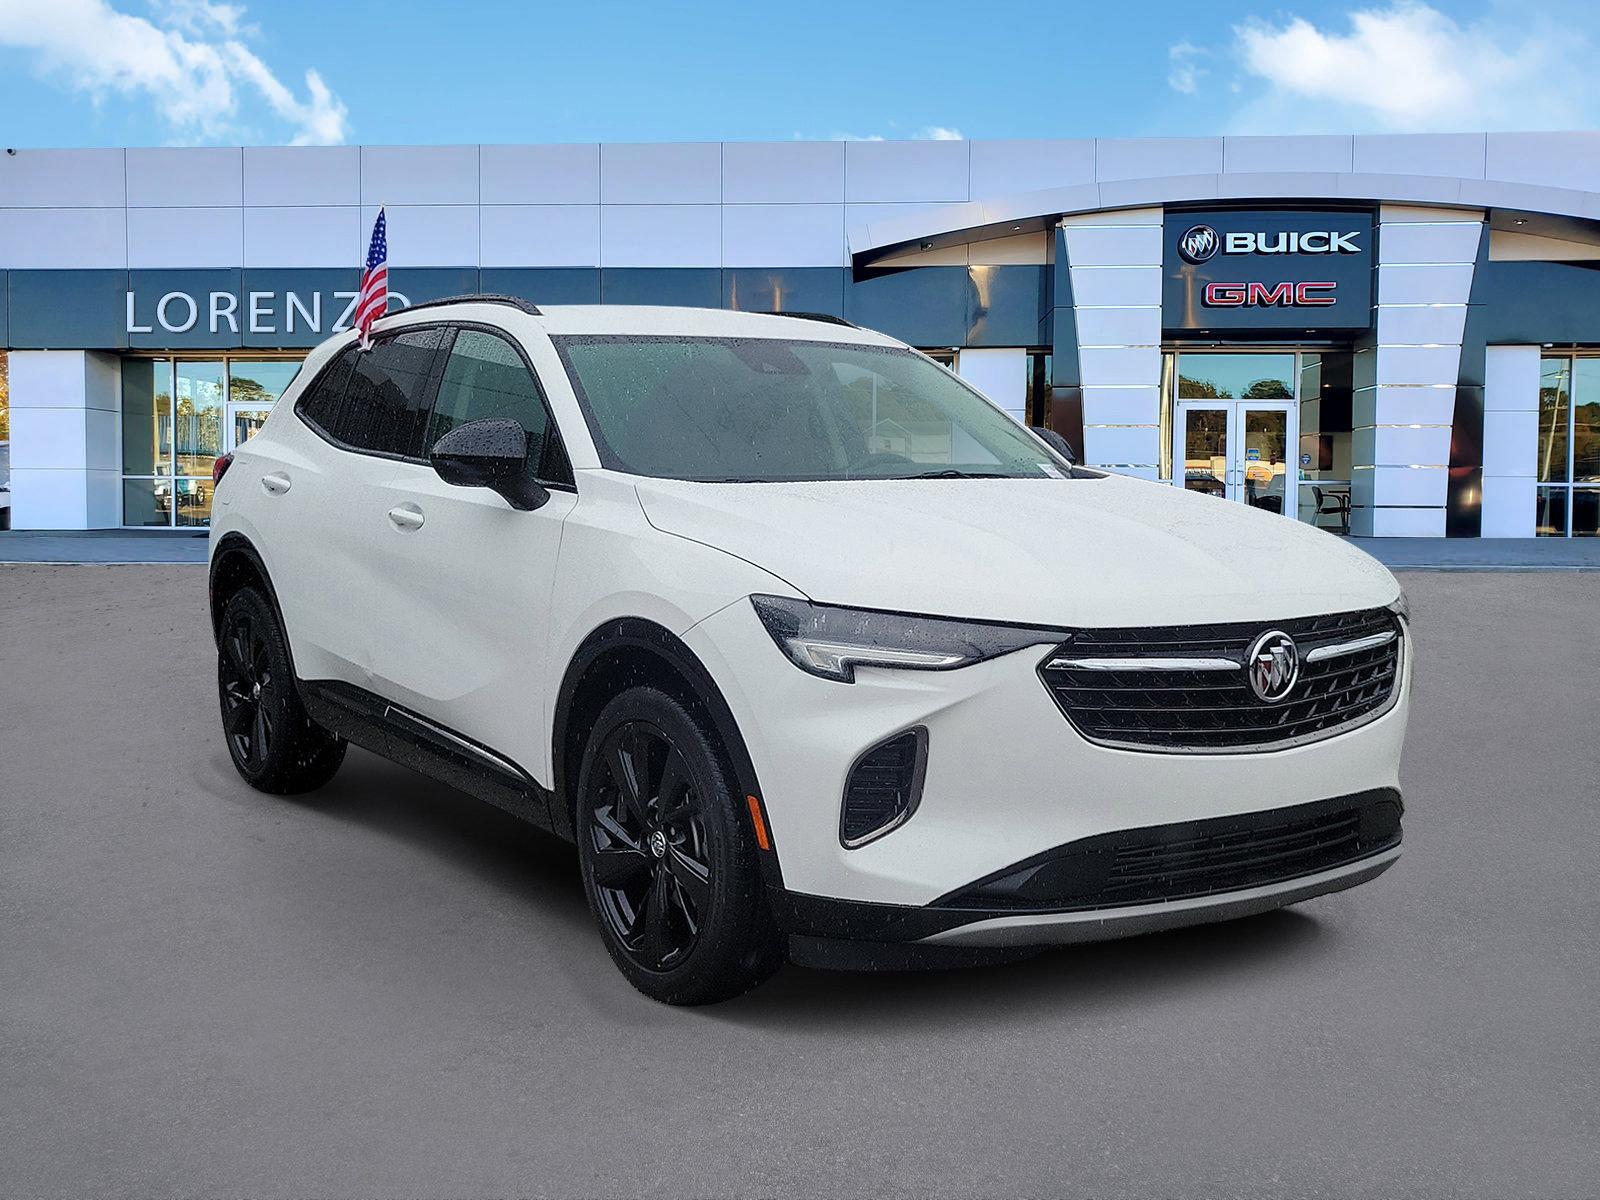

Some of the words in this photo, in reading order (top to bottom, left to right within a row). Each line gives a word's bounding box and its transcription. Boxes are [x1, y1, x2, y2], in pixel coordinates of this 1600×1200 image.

[1225, 231, 1362, 253] BUICK
[1205, 281, 1337, 305] GMC
[126, 291, 412, 333] LORENZ
